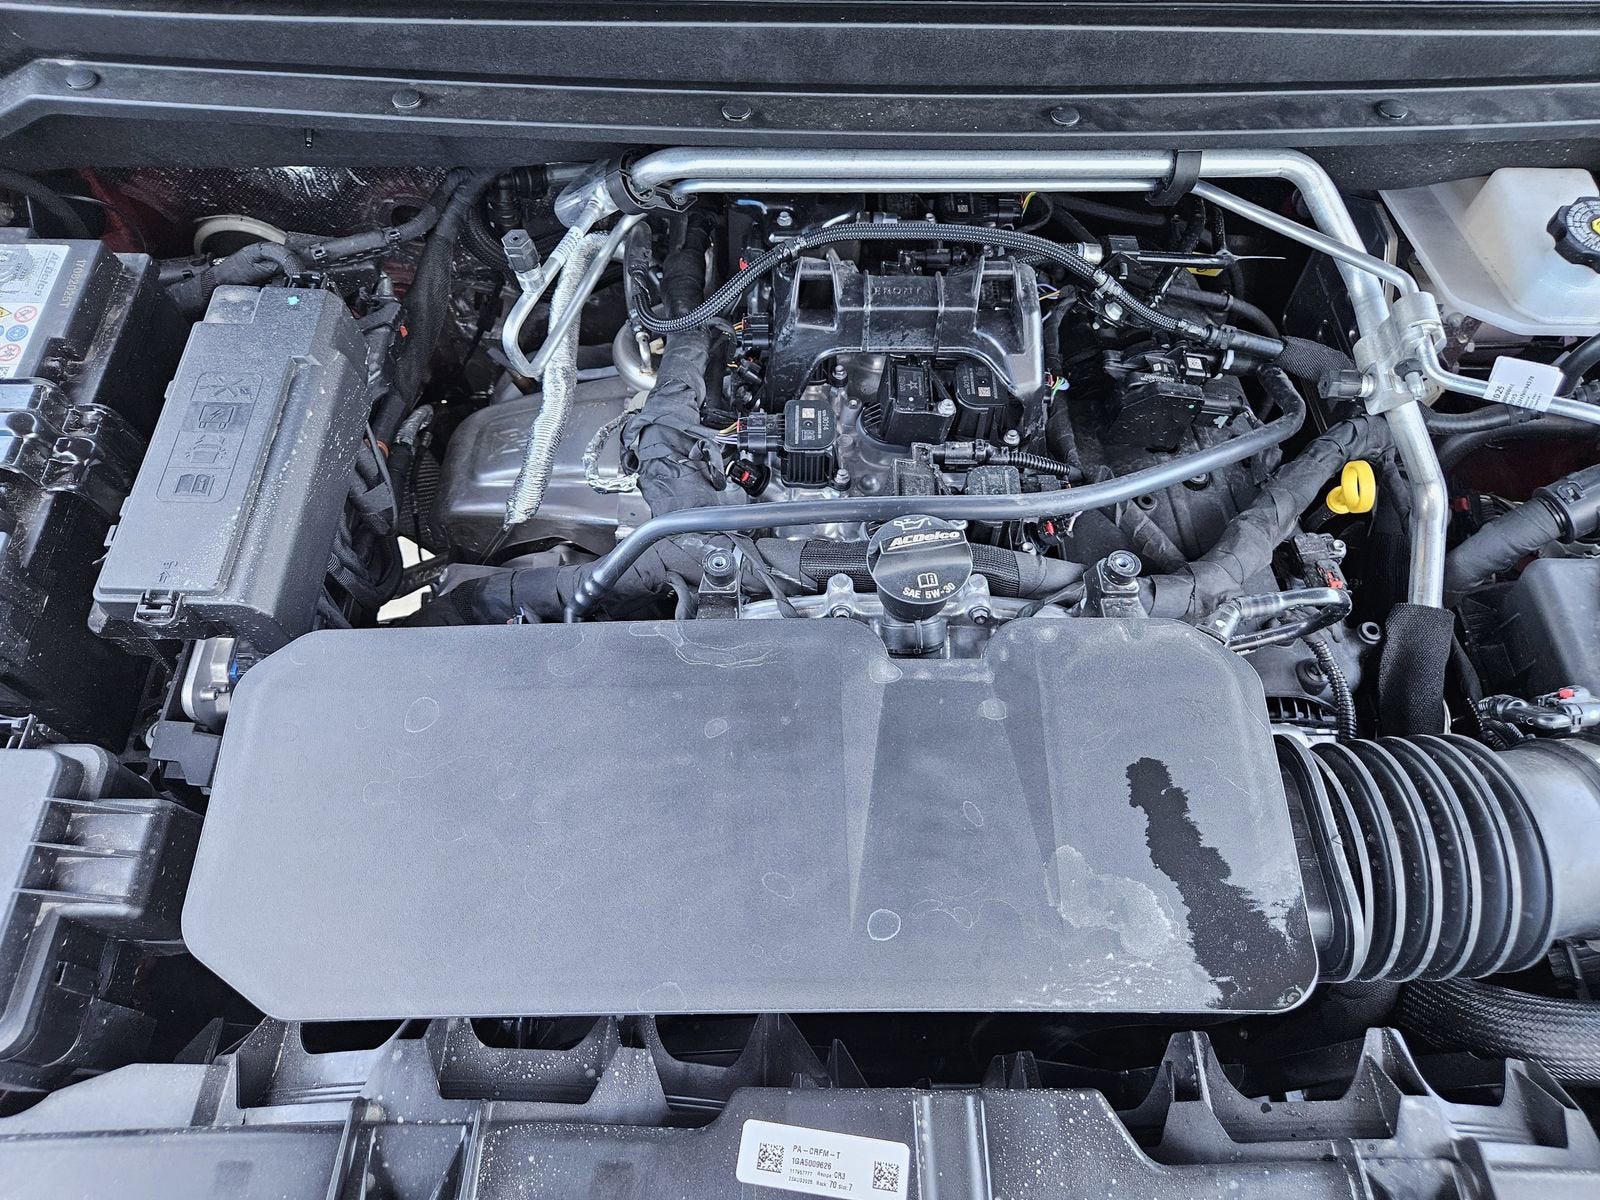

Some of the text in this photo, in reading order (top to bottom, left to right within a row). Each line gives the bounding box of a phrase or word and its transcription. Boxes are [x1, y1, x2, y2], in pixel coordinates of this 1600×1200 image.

[889, 531, 960, 547] ACDelco
[902, 582, 956, 599] SAE 5W-30
